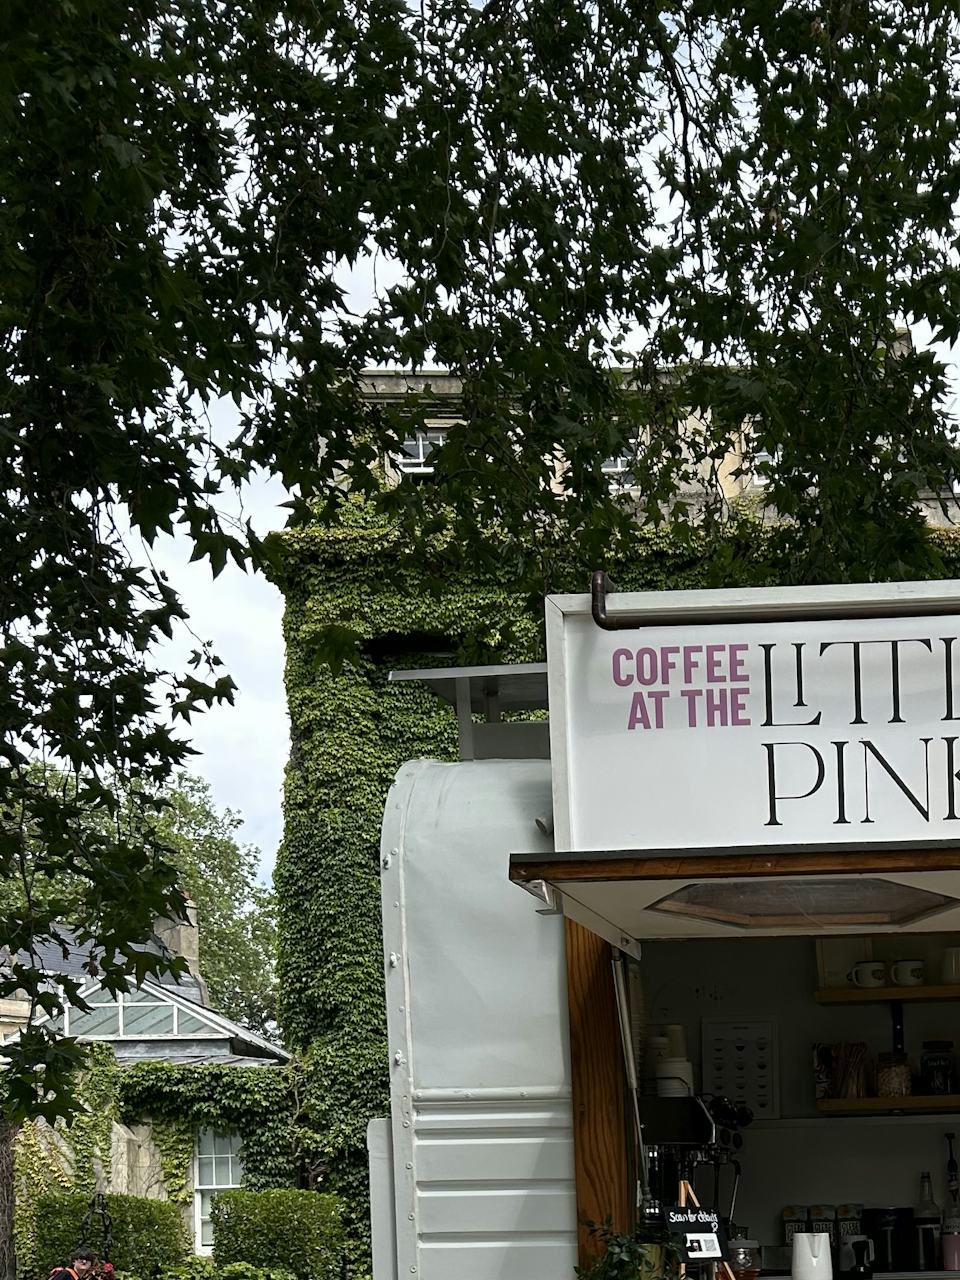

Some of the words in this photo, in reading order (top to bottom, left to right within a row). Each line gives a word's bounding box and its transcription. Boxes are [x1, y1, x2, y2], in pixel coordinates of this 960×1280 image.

[612, 644, 750, 687] COFFEE
[627, 690, 670, 730] AT
[680, 687, 751, 728] THE
